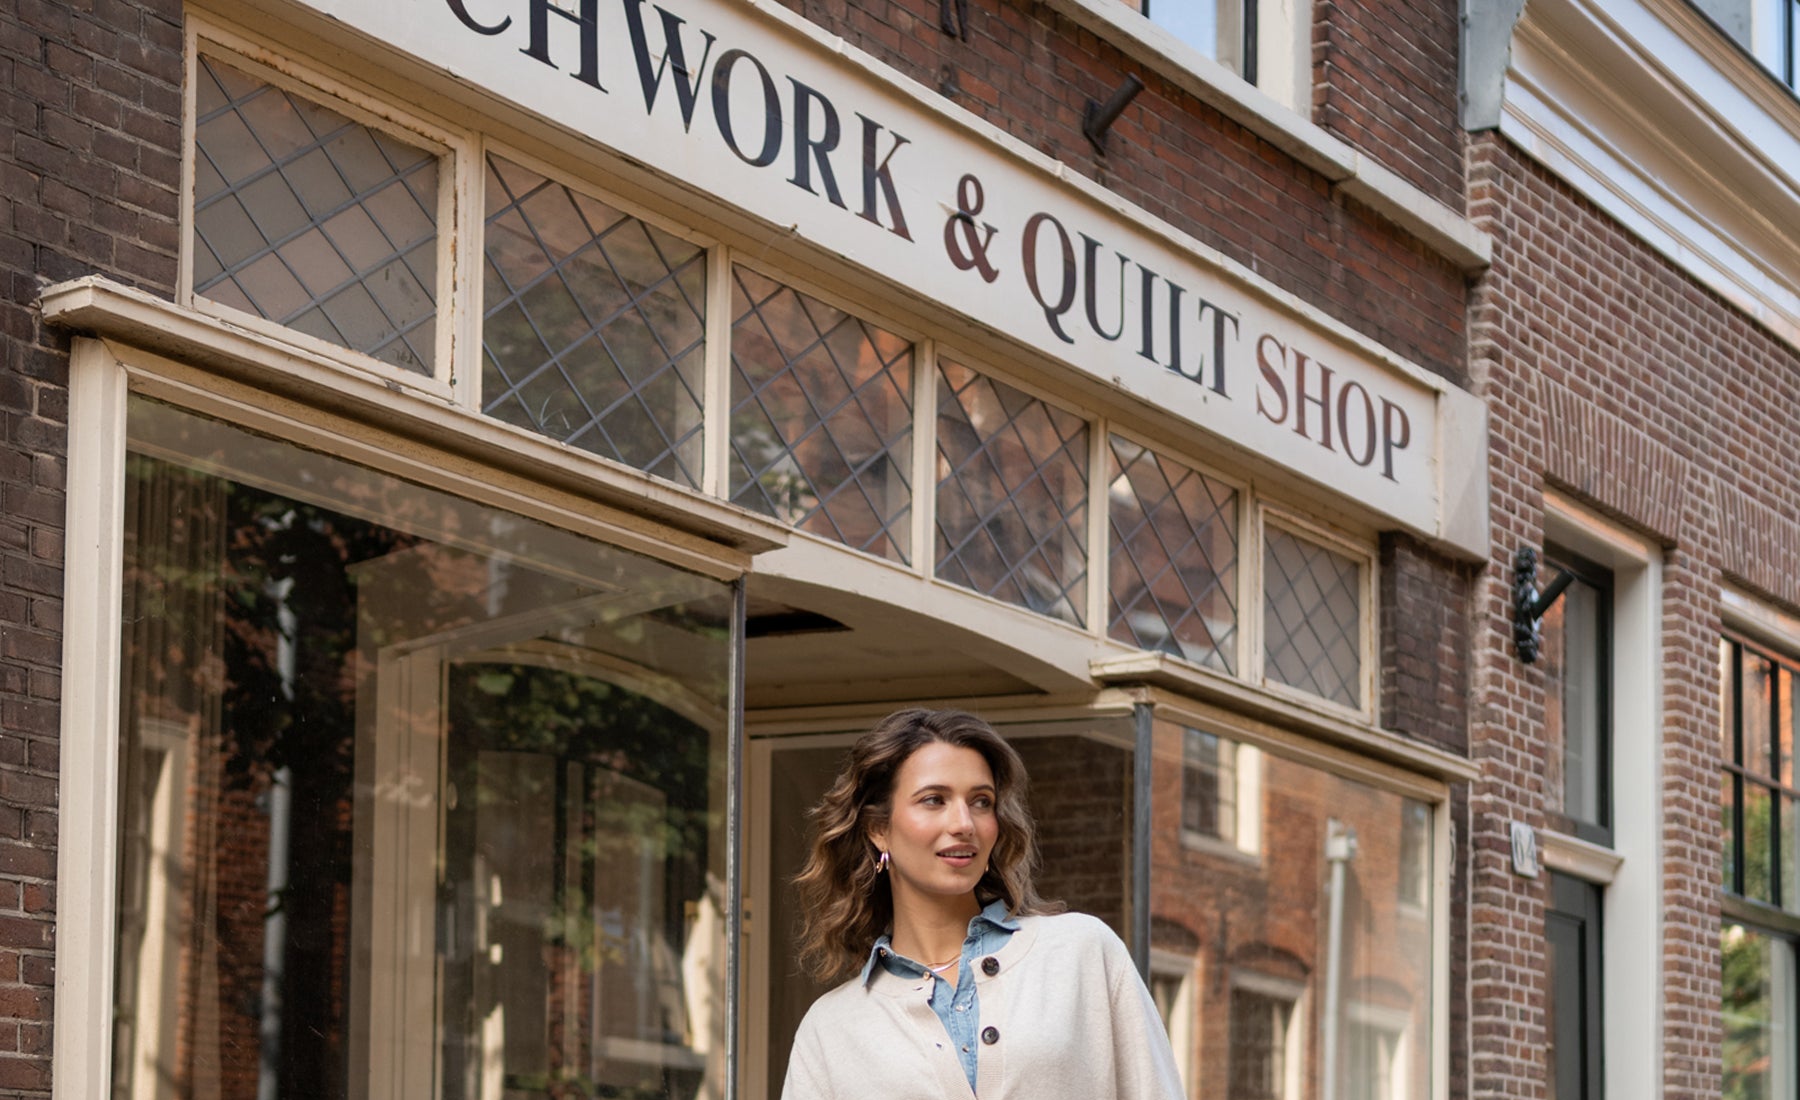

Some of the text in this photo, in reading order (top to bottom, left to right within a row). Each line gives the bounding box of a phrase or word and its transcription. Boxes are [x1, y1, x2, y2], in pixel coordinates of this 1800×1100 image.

[446, 0, 1411, 483] HWORK & QUILT SHOP
